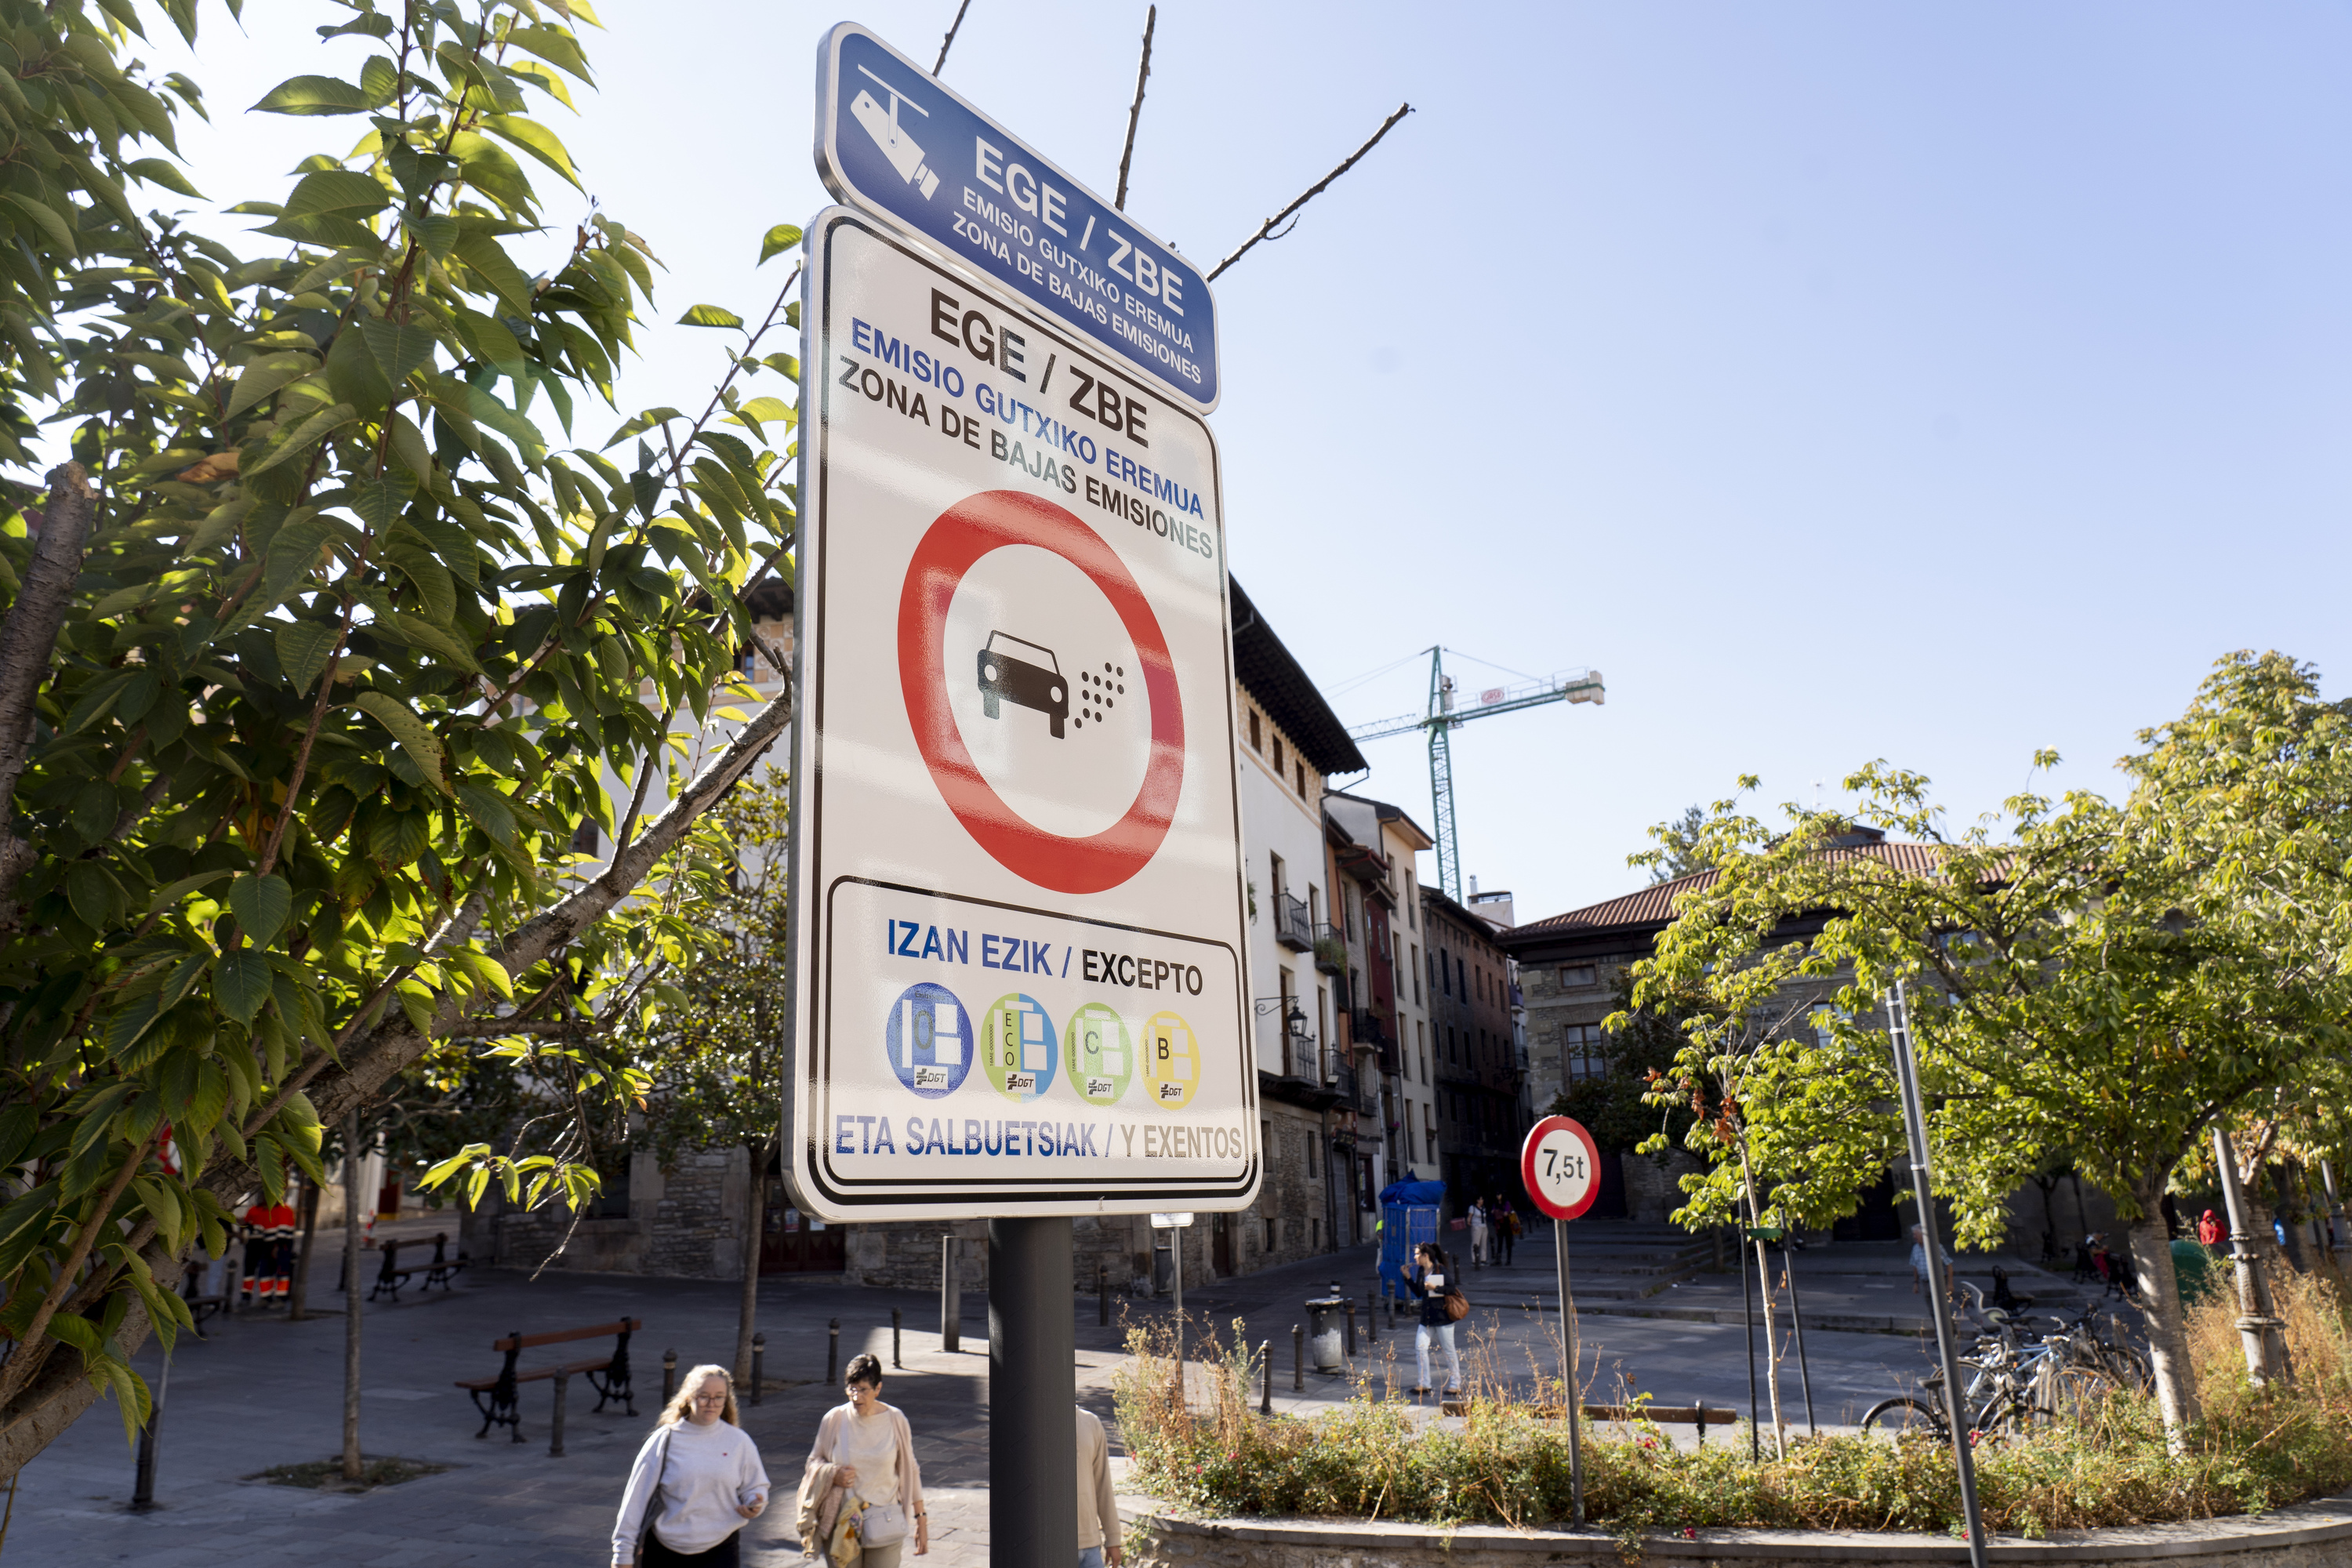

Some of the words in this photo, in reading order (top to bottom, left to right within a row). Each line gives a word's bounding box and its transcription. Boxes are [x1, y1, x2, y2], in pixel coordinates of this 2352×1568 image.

[976, 136, 1067, 238] EGE
[1080, 215, 1096, 251] /
[1108, 228, 1184, 317] ZBE
[964, 186, 1033, 246] EMISIO
[1040, 238, 1120, 303] GUTXIKO
[1125, 292, 1193, 354] EREMUA
[953, 211, 1011, 266] ZONA
[1018, 252, 1043, 285] DE
[1049, 272, 1107, 325] BAJAS
[1112, 312, 1201, 384] EMISIONES
[931, 287, 1026, 383] EGE
[1040, 353, 1056, 394] /
[1069, 365, 1149, 448] ZBE
[852, 317, 964, 397] EMISIO
[975, 383, 1097, 464] GUTXIKO
[1106, 447, 1204, 521] EREMUA
[839, 354, 931, 426] ZONA
[942, 404, 980, 450] DE
[991, 429, 1076, 494] BAJAS
[1086, 474, 1213, 559] EMISIONES
[888, 919, 967, 964] IZAN
[982, 933, 1053, 975] EZIK
[1062, 946, 1072, 978] /
[1083, 949, 1203, 996] EXCEPTO
[1005, 1013, 1014, 1065] ECO
[1085, 1031, 1099, 1054] C
[1158, 1037, 1169, 1060] B
[927, 1073, 946, 1083] DGT
[1018, 1078, 1034, 1087] DGT
[1098, 1083, 1112, 1092] DGT
[1169, 1087, 1182, 1096] DGT
[836, 1115, 895, 1154] ETA
[906, 1116, 1098, 1156] SALBUETSIAK
[1105, 1123, 1113, 1157] /
[1120, 1124, 1136, 1157] Y
[1144, 1124, 1242, 1159] EXENTOS
[1543, 1149, 1584, 1185] 7,5t
